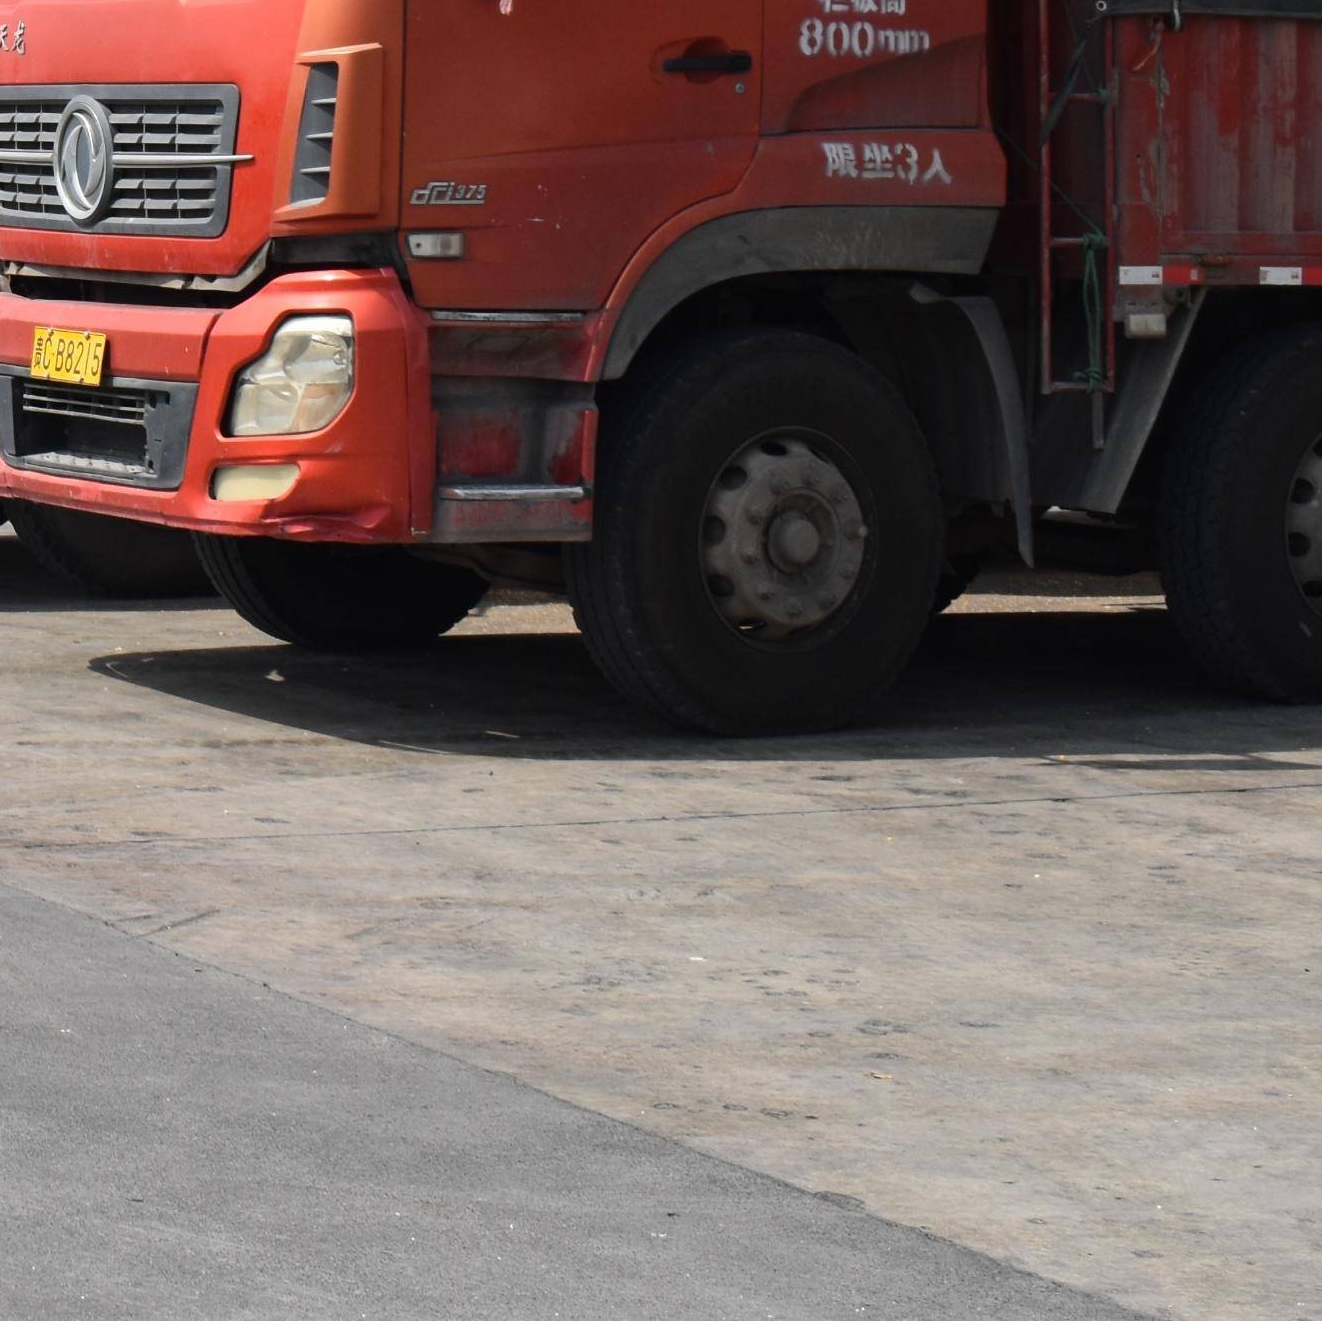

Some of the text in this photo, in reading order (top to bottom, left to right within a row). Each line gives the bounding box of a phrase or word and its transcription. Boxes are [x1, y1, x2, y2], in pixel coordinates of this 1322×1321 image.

[798, 17, 930, 58] 800mm
[821, 142, 952, 185] 限坐3人
